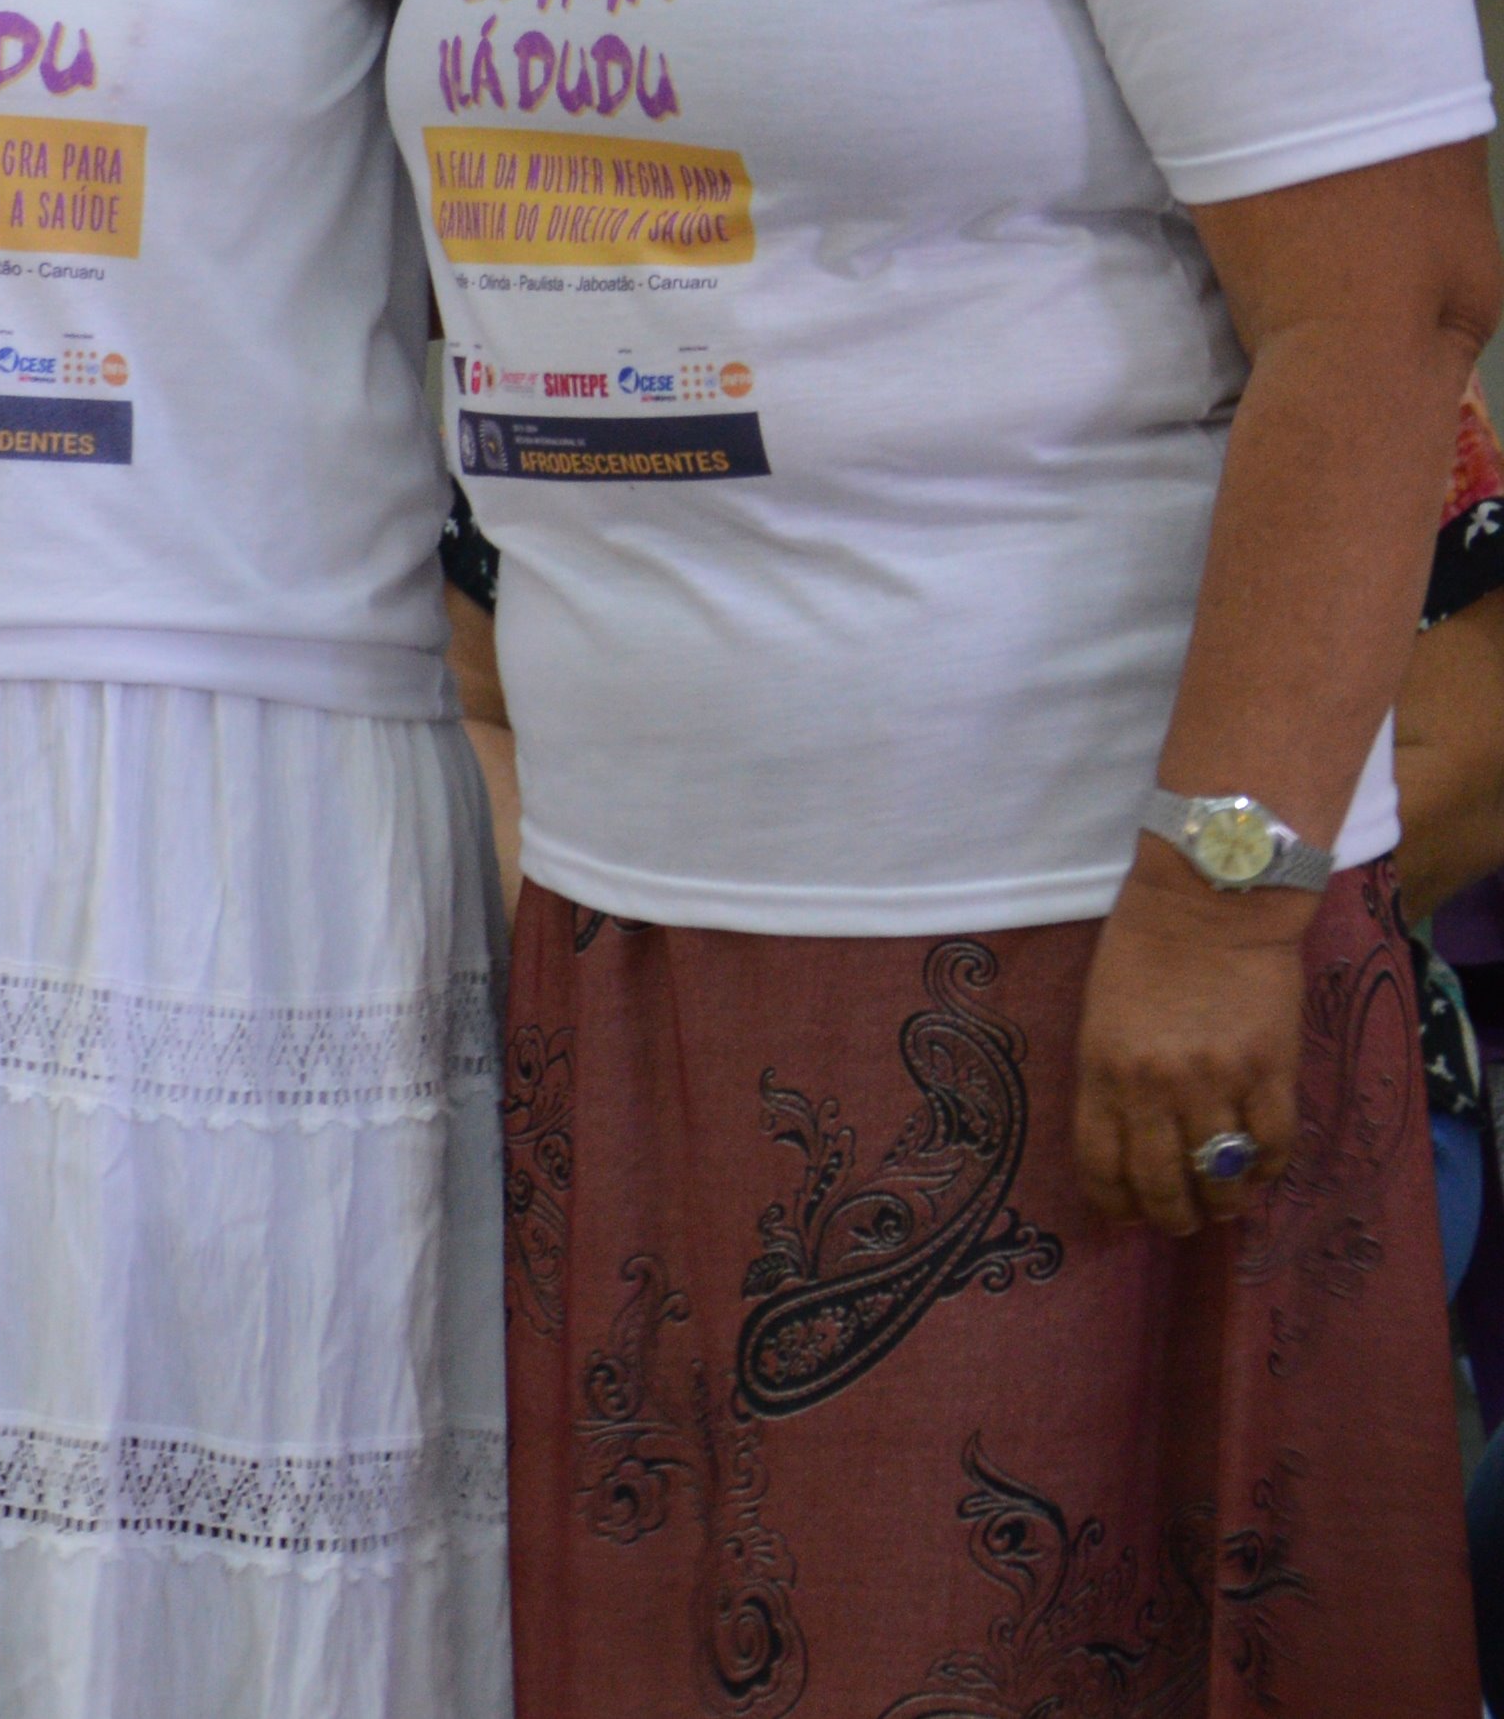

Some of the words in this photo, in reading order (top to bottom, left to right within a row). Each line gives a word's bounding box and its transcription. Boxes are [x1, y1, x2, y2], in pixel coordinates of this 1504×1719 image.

[439, 13, 506, 114] ILÁ
[513, 30, 681, 119] DUDU
[62, 142, 123, 184] PARA
[449, 150, 486, 189] FALA
[494, 152, 519, 189] DA
[526, 153, 604, 195] MULHER
[612, 157, 677, 200] NEGRA
[680, 165, 733, 203] PARA
[10, 189, 25, 227] A
[38, 186, 120, 234] SAÚDE
[440, 200, 507, 240] GARANTIA
[514, 202, 541, 242] DO
[546, 203, 631, 244] DIREITO
[626, 208, 649, 241] A
[648, 206, 731, 247] SAÚDE
[38, 263, 105, 281] Caruaru
[647, 274, 719, 290] Caruaru
[18, 356, 57, 374] CESE
[543, 372, 610, 398] SINTEPE
[640, 374, 675, 392] CESE
[520, 450, 731, 475] AFRODESCENDENTES
